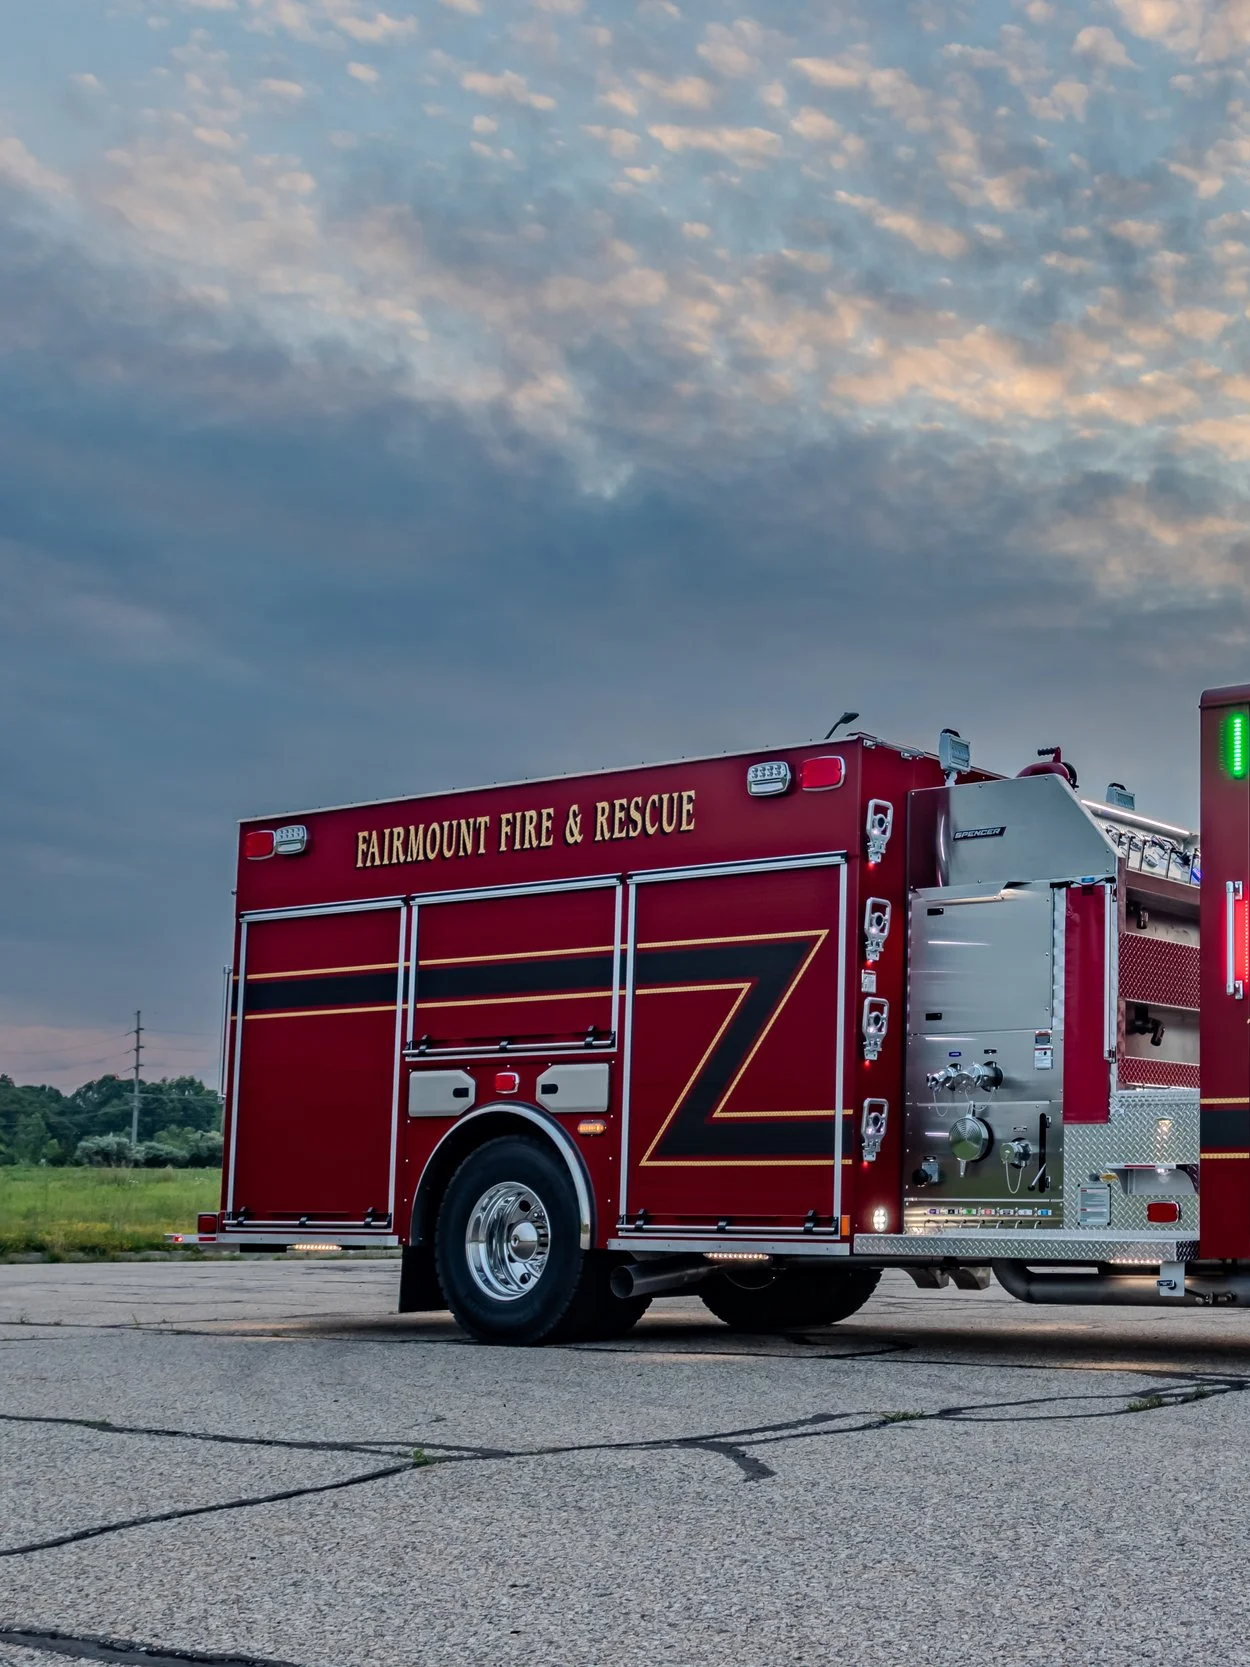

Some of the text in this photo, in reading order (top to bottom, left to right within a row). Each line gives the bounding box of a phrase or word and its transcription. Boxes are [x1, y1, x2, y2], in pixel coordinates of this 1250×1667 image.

[355, 789, 696, 868] FAIRMOUNT FIRE & RESCUE
[954, 828, 1001, 839] SPENCER
